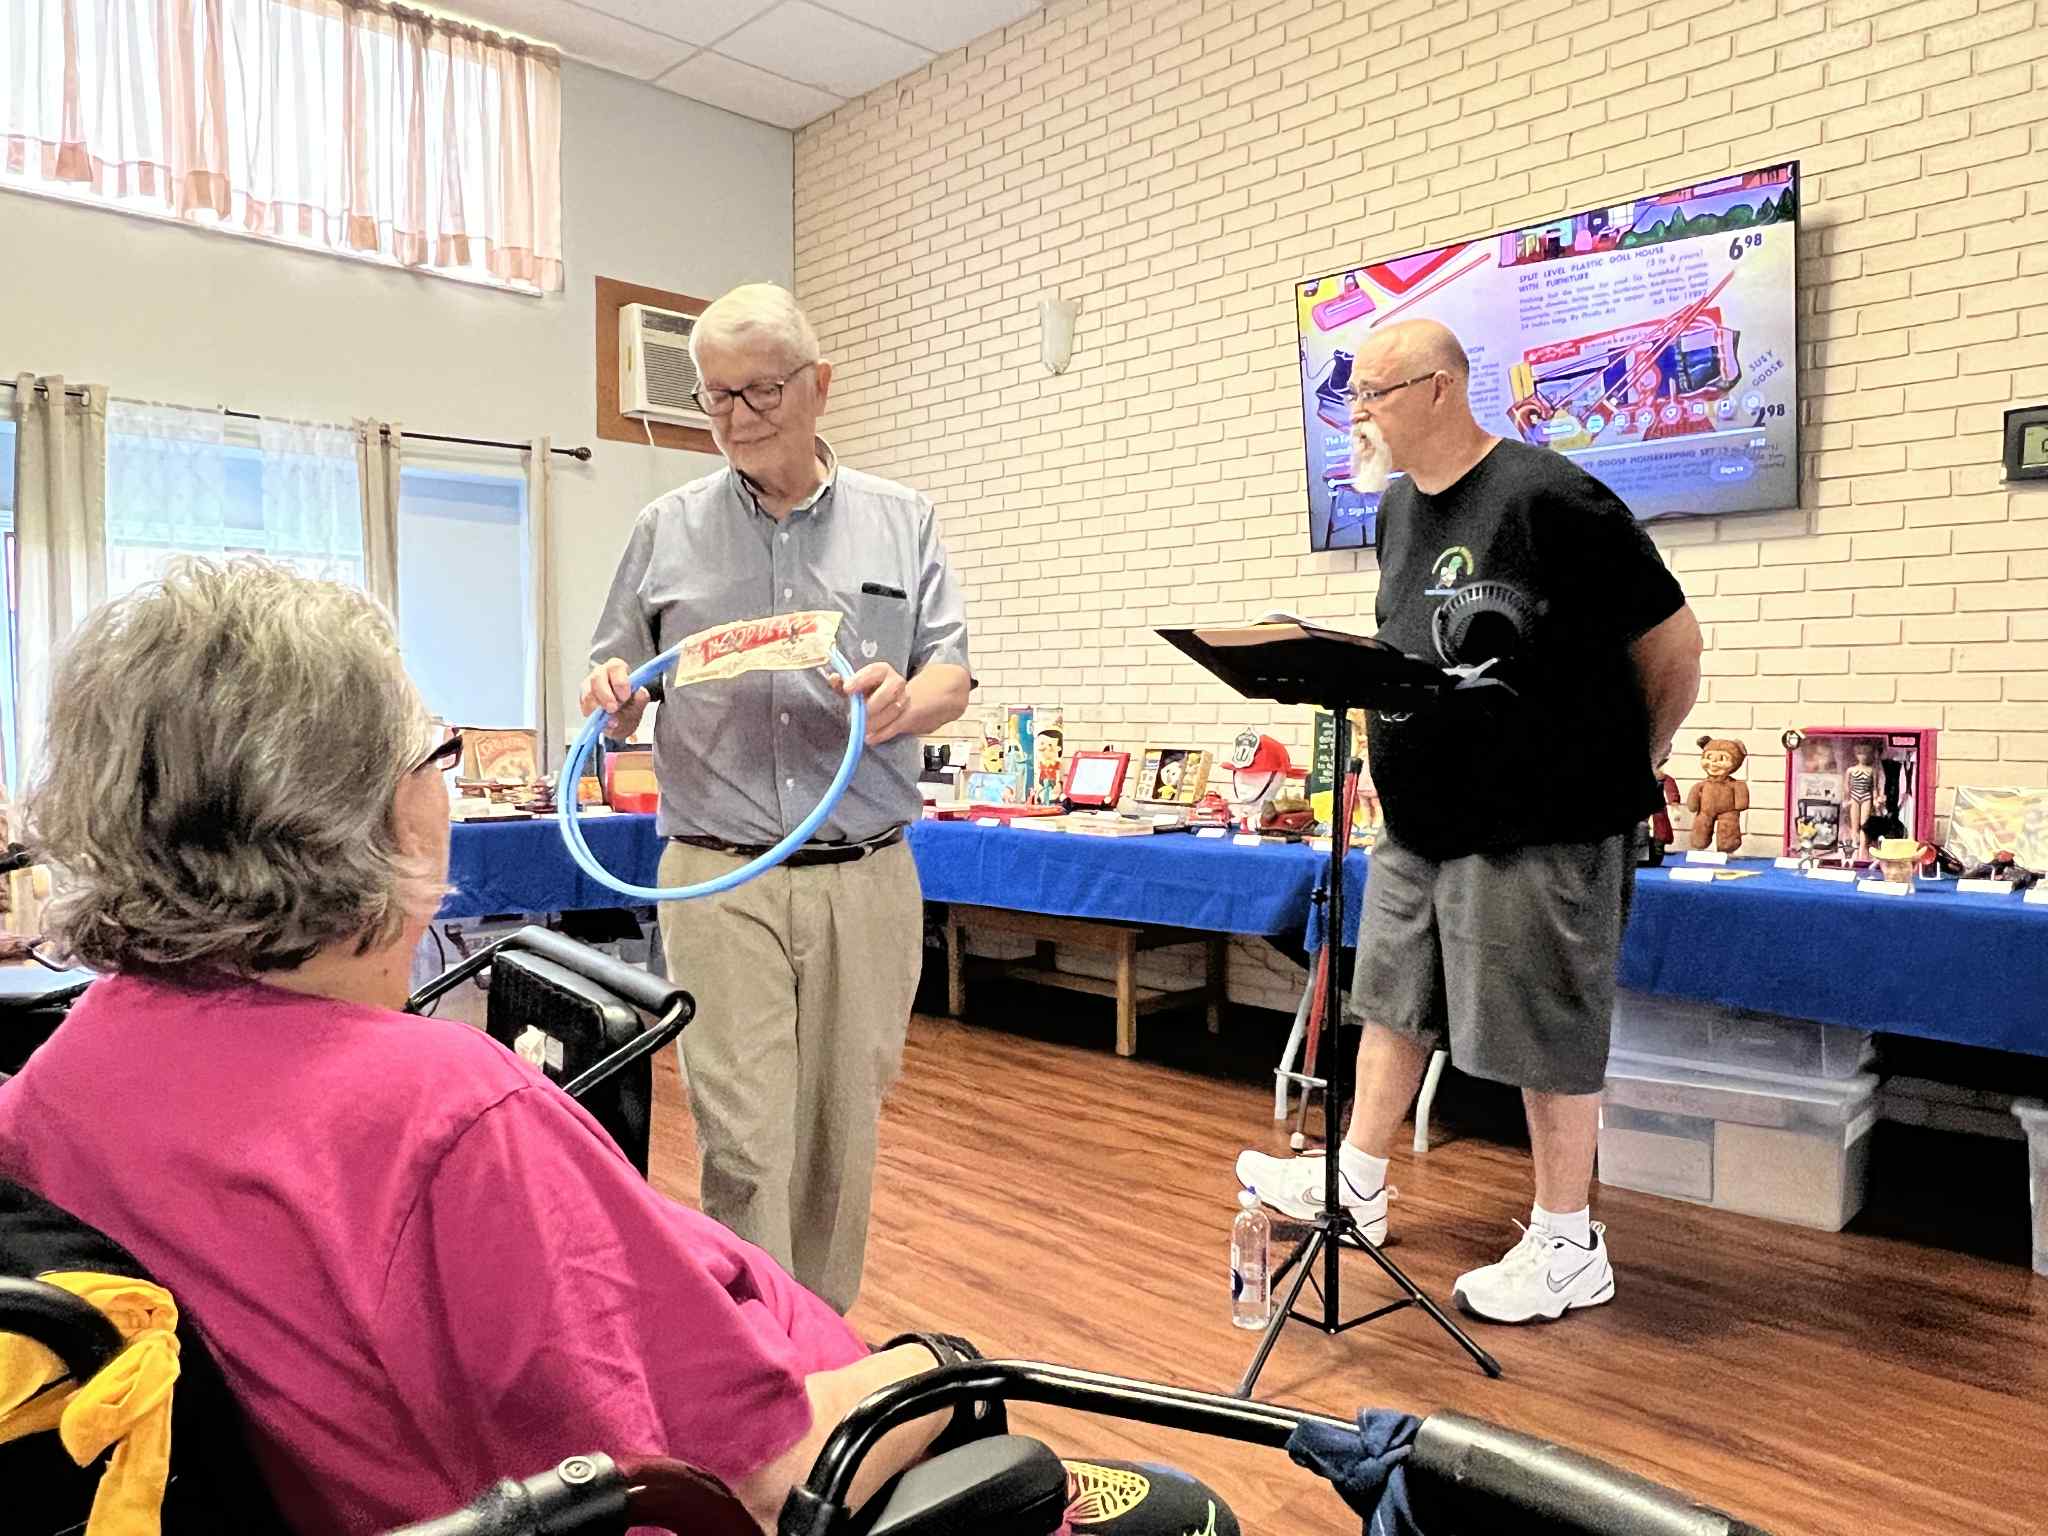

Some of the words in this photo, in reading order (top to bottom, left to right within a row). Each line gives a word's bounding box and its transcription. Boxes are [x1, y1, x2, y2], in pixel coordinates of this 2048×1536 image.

[1519, 272, 1538, 283] SPLIT
[1543, 267, 1566, 278] LEVEL
[1571, 258, 1603, 272] PLASTIC
[1609, 254, 1631, 264] DOLL
[1635, 247, 1664, 259] HOUSE
[1518, 282, 1539, 292] WITH
[1546, 272, 1589, 287] FURNITURE
[1752, 360, 1784, 386] GOOSE
